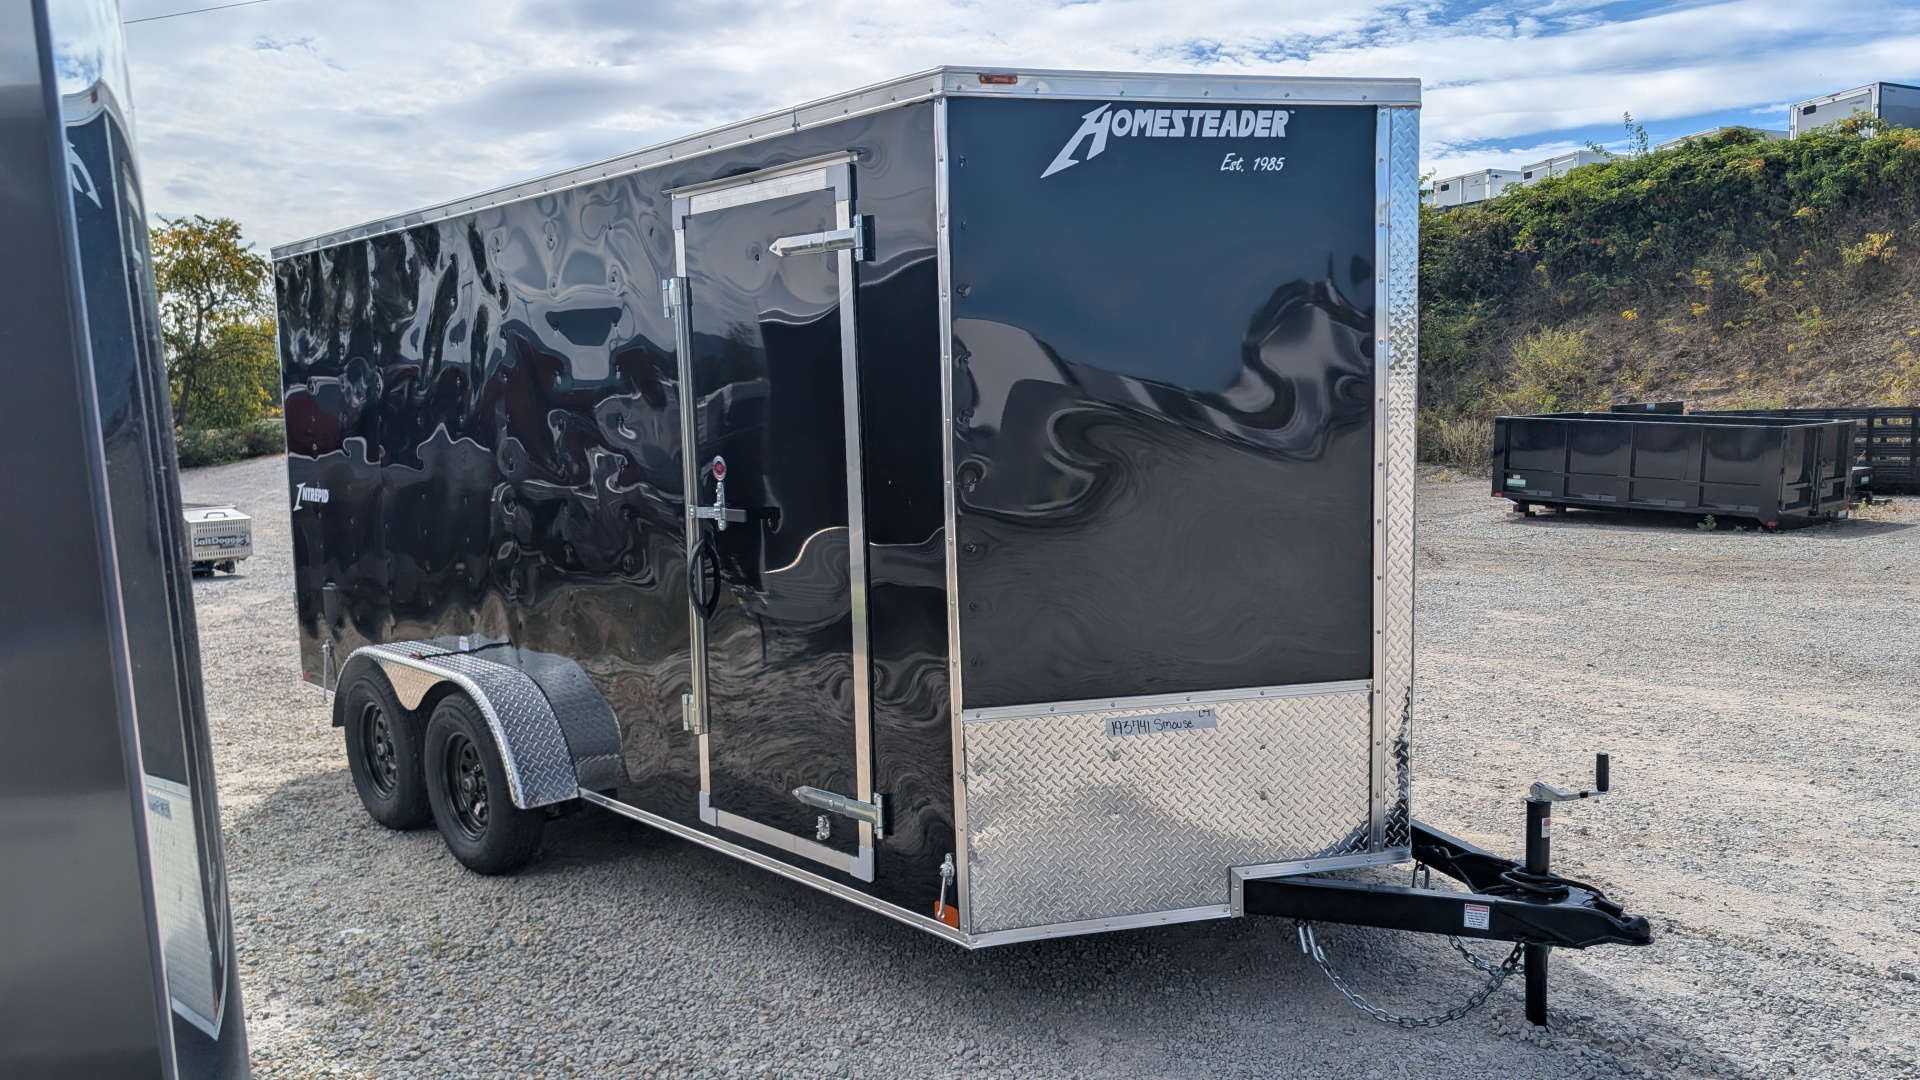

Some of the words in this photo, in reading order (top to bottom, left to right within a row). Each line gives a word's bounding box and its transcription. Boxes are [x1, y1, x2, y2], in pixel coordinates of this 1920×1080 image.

[1040, 102, 1289, 178] HOMESTEADER
[1220, 152, 1244, 172] Est.
[1253, 157, 1285, 171] 1985
[293, 482, 329, 511] INTREPID
[1111, 720, 1151, 735] 193741
[1154, 718, 1195, 732] Smouse
